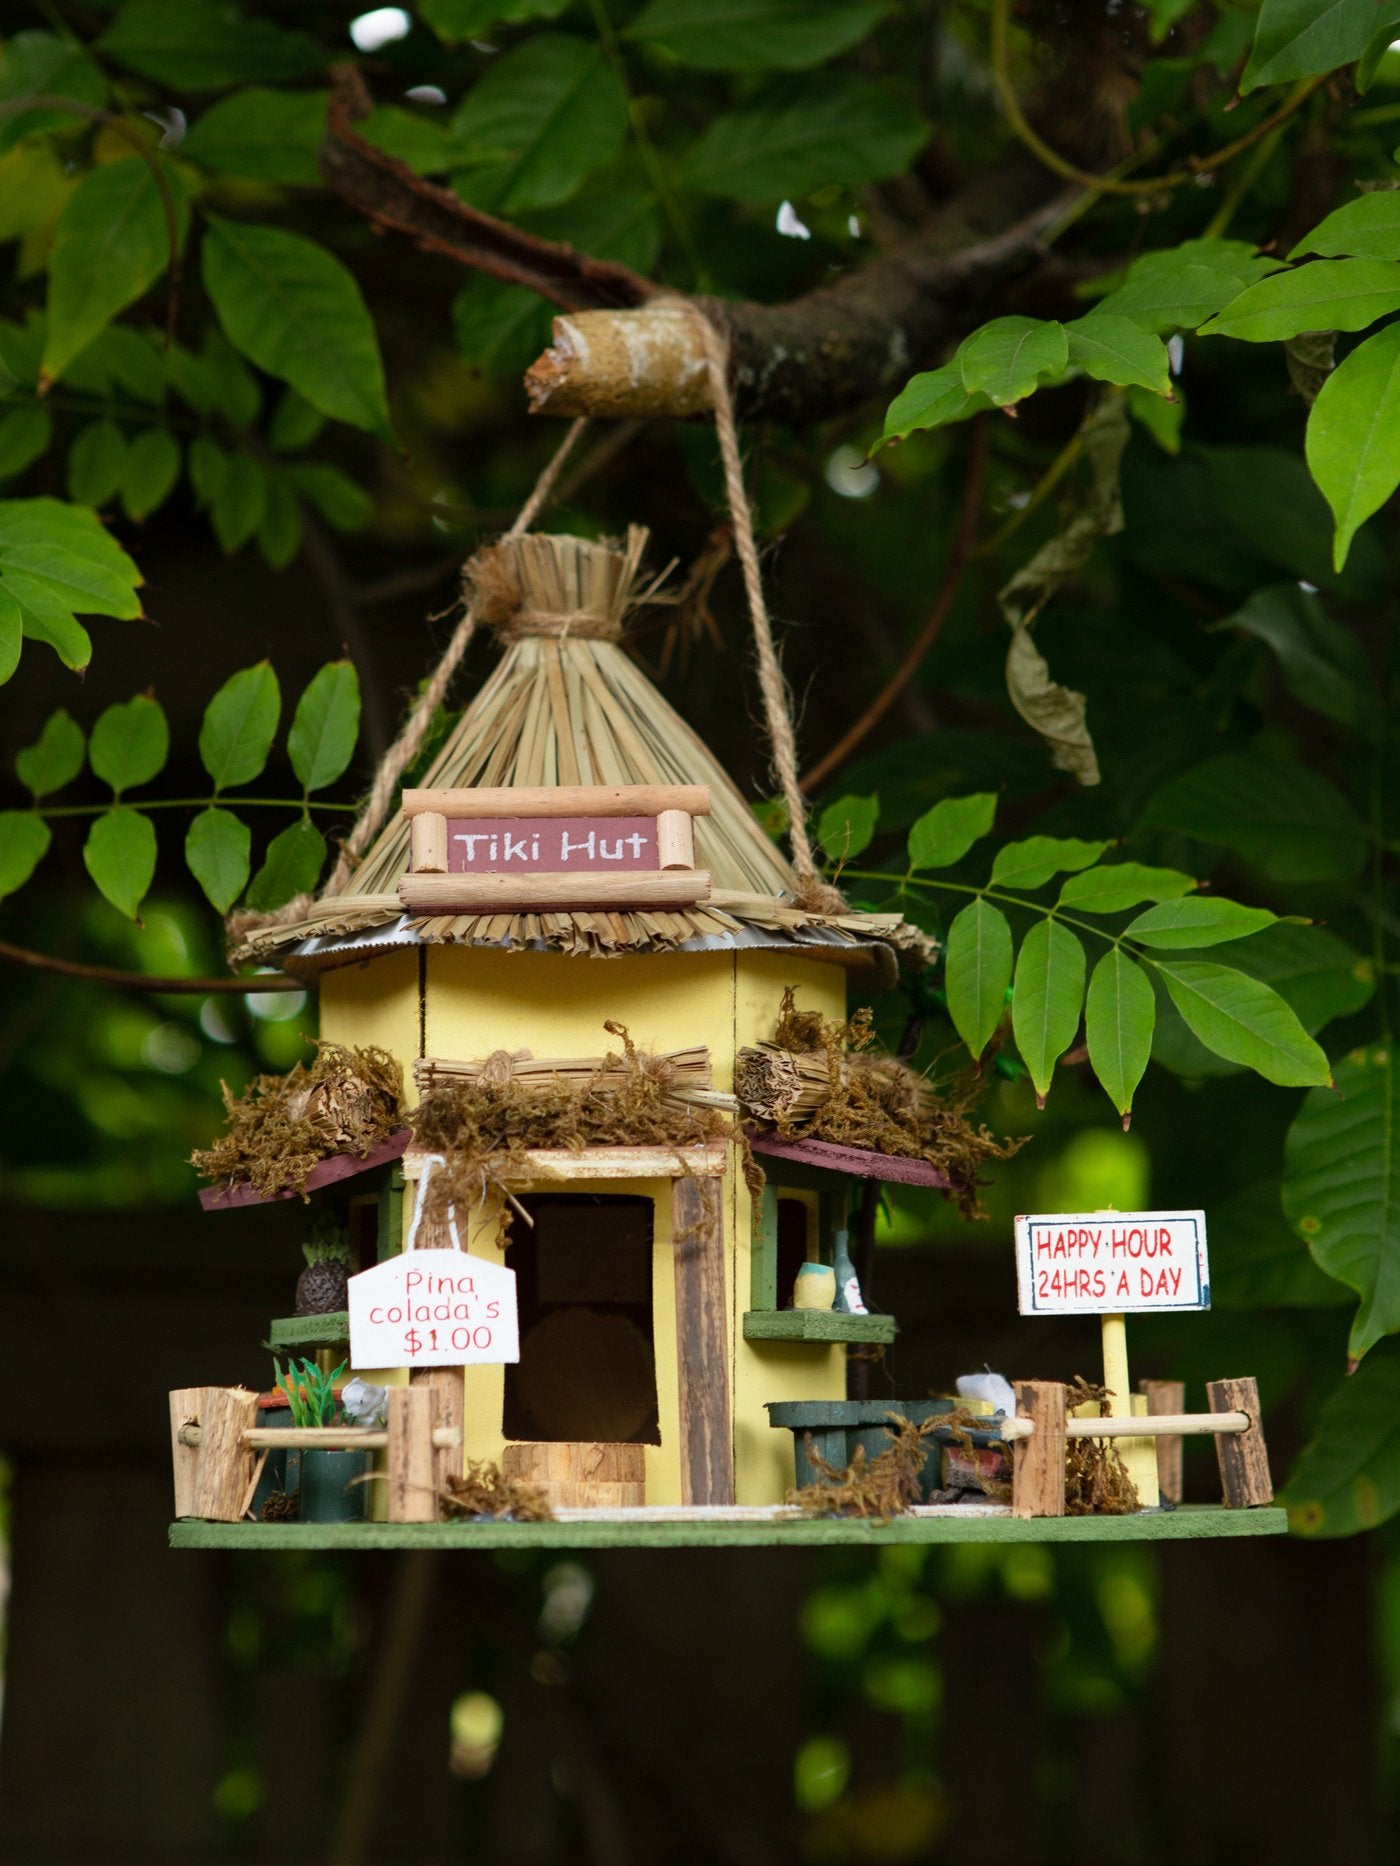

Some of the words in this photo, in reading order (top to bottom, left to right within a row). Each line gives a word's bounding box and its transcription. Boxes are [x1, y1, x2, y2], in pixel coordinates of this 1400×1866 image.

[453, 832, 540, 861] Tiki
[561, 831, 648, 860] Hut
[1037, 1229, 1102, 1259] HAPPY
[1112, 1228, 1172, 1258] HOUR
[406, 1271, 475, 1295] Pina
[1038, 1268, 1106, 1298] 24HRS
[1116, 1270, 1130, 1296] A
[1140, 1267, 1182, 1297] DAY
[369, 1294, 500, 1324] colada's
[403, 1326, 492, 1357] $1.00
